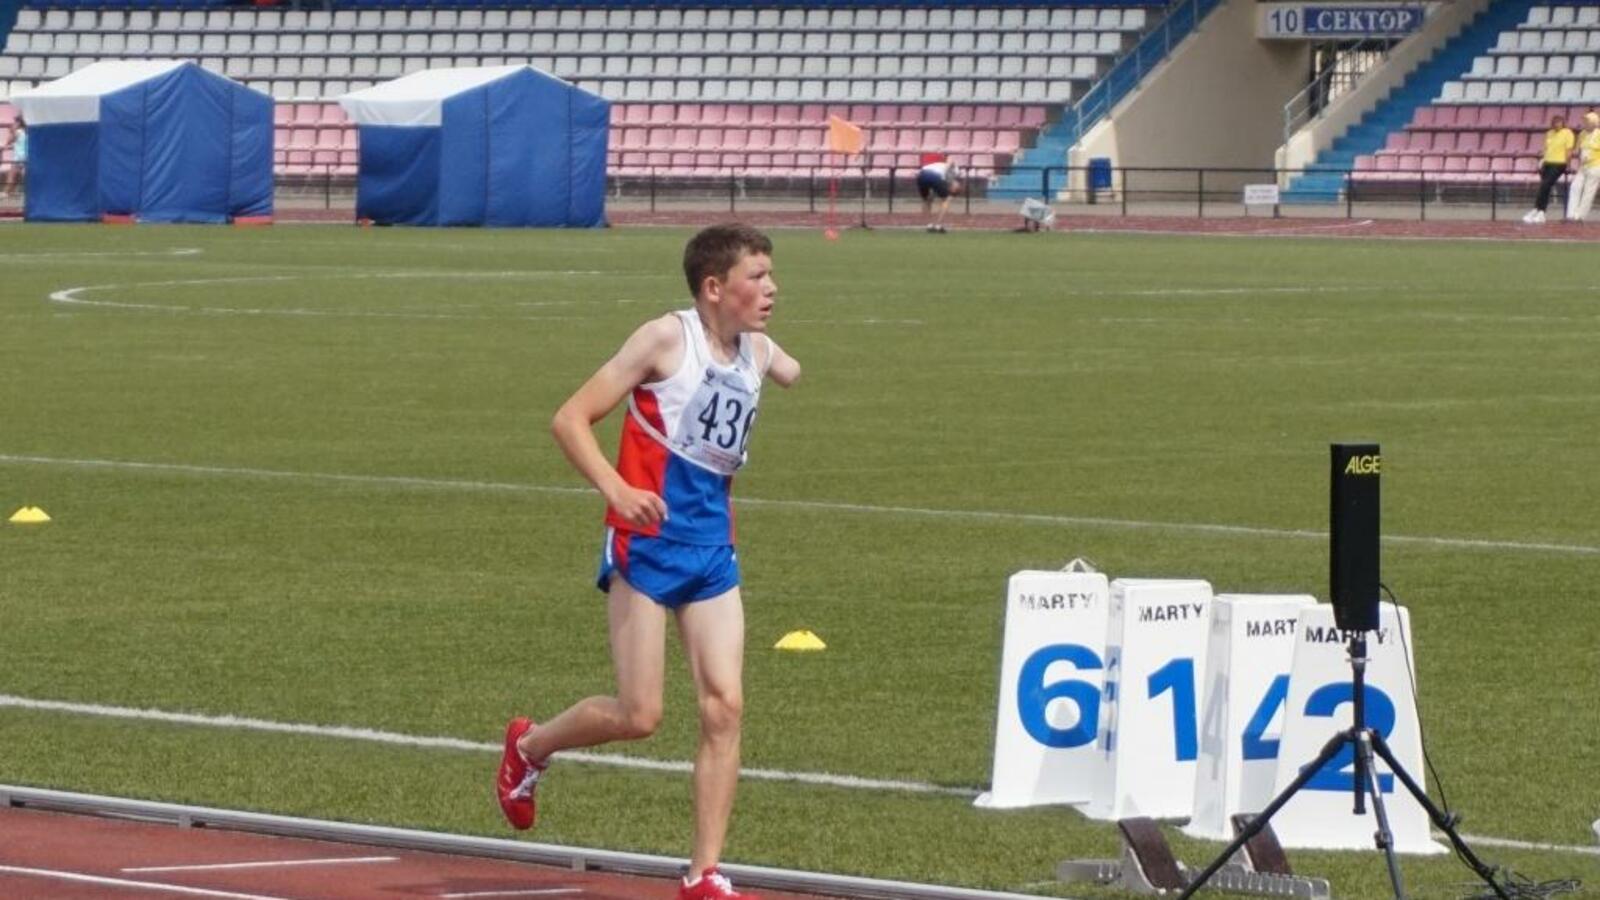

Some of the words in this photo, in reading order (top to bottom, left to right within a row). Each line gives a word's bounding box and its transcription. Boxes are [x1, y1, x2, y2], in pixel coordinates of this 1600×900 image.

[1271, 9, 1298, 33] 10
[1344, 454, 1381, 474] ALGE
[1138, 603, 1203, 622] MARTY
[1246, 618, 1298, 638] MART
[1305, 626, 1387, 645] MARY
[1016, 643, 1104, 749] 6
[1147, 656, 1199, 762] 1
[1299, 681, 1396, 794] 2
